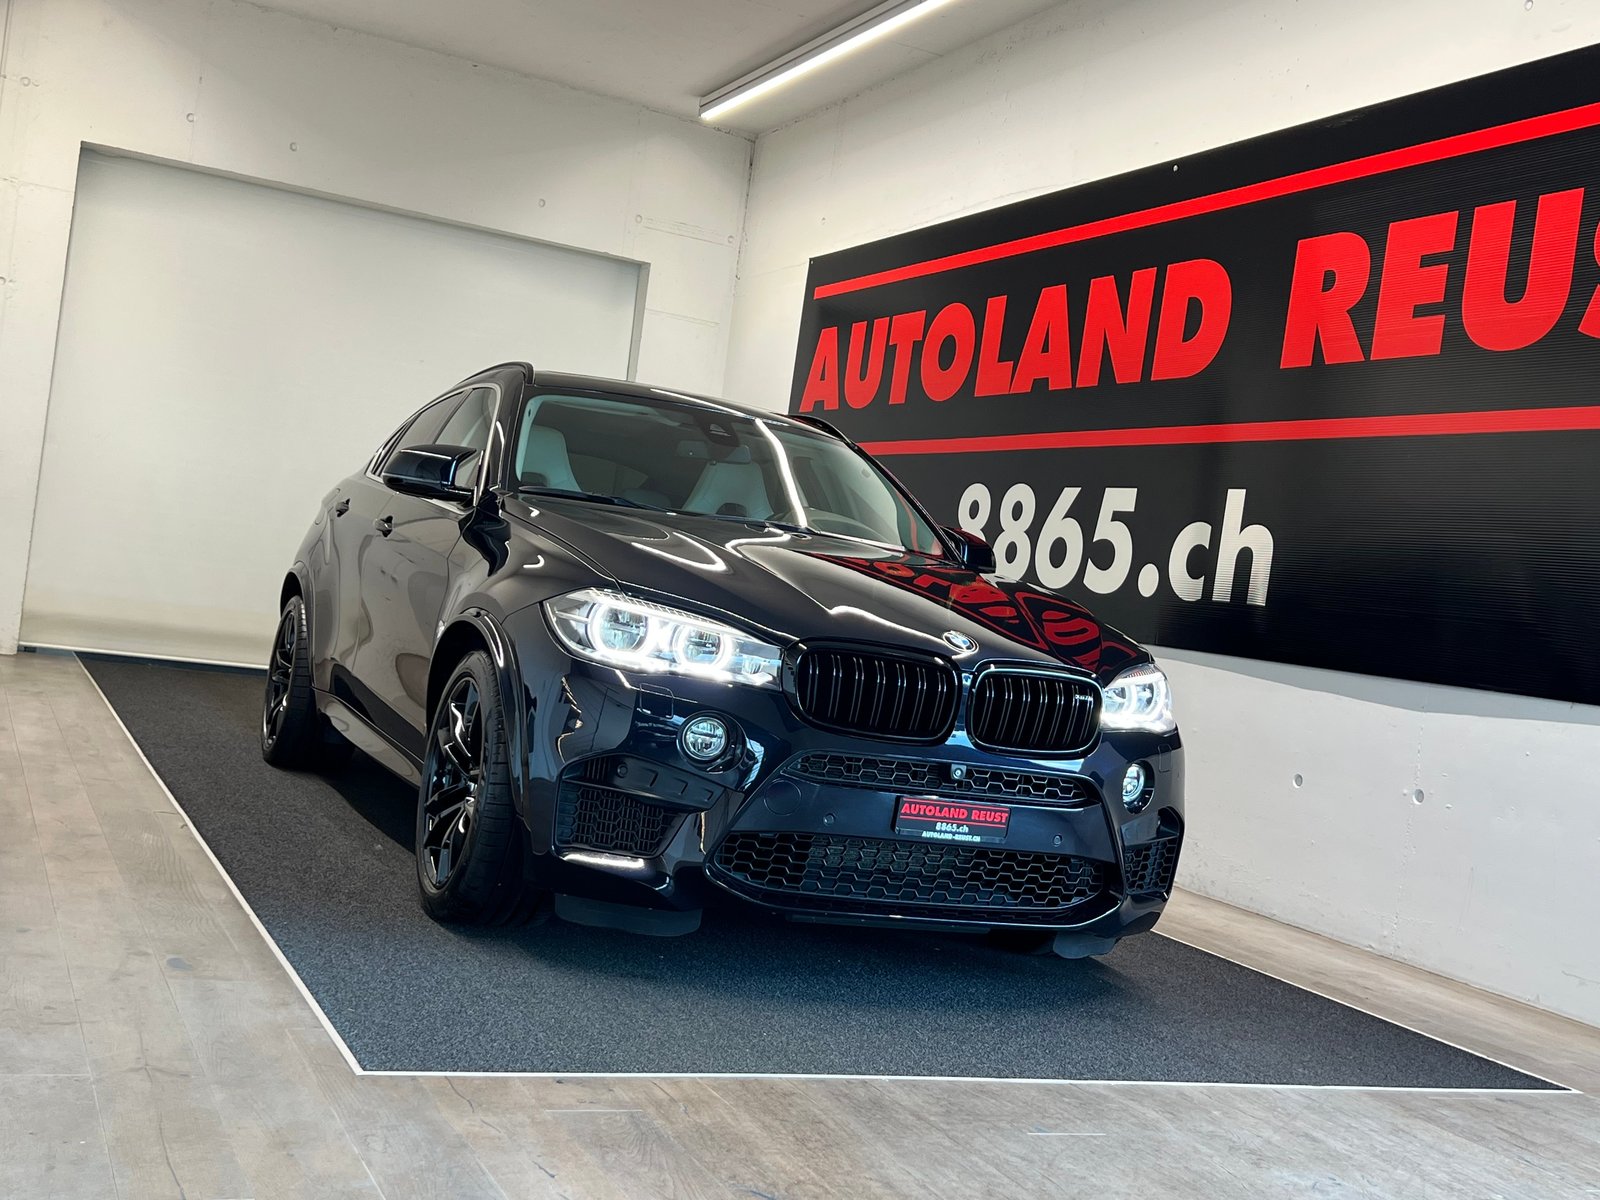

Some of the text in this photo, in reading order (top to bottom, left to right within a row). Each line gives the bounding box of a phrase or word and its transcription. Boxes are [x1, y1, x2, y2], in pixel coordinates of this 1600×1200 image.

[800, 187, 1600, 413] AUTOLAND REU
[901, 803, 1009, 823] AUTOLAND REUST
[935, 822, 969, 833] 8865.ch
